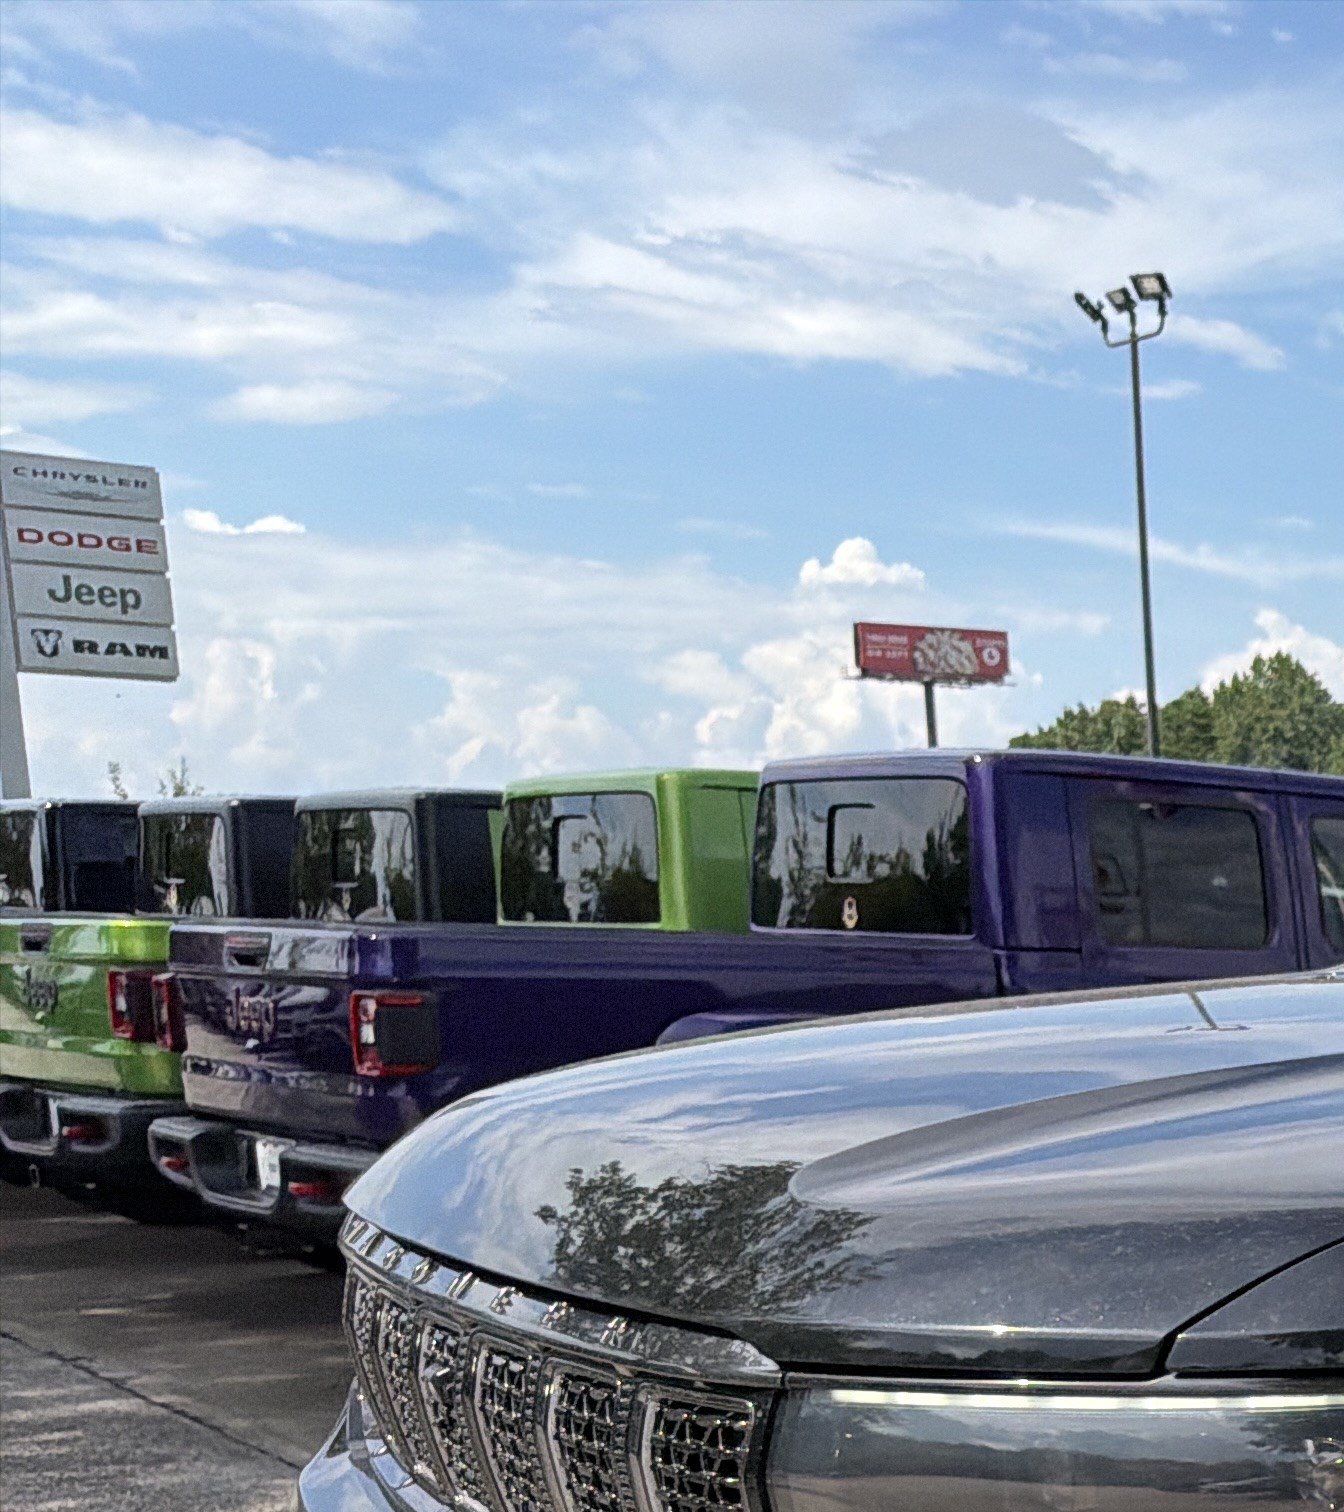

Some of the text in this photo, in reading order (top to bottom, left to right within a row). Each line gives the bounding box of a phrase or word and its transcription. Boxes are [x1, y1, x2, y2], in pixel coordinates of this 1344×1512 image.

[13, 466, 148, 490] CHRYSLER
[16, 527, 159, 554] DODGE
[47, 574, 142, 615] Jeep
[72, 639, 169, 660] RAM
[226, 986, 276, 1043] Jeep
